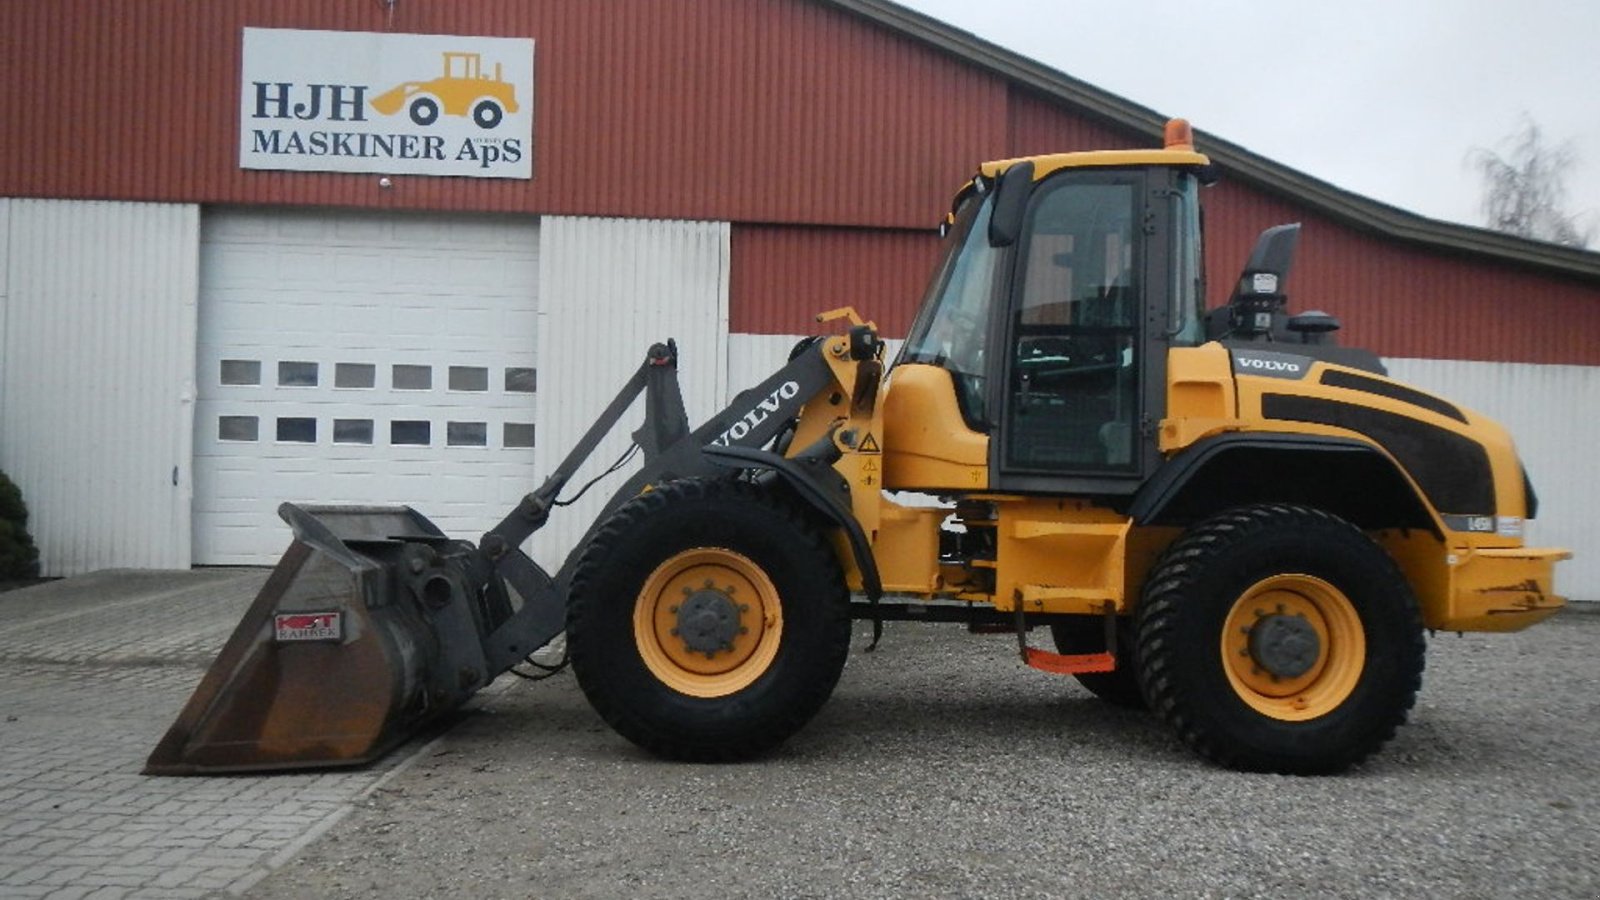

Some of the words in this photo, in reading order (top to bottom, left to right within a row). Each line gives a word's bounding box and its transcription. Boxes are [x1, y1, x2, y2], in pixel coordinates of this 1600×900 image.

[251, 81, 368, 121] HJH
[251, 129, 446, 160] MASKINER
[455, 137, 522, 168] ApS
[1238, 357, 1300, 372] VOLVO
